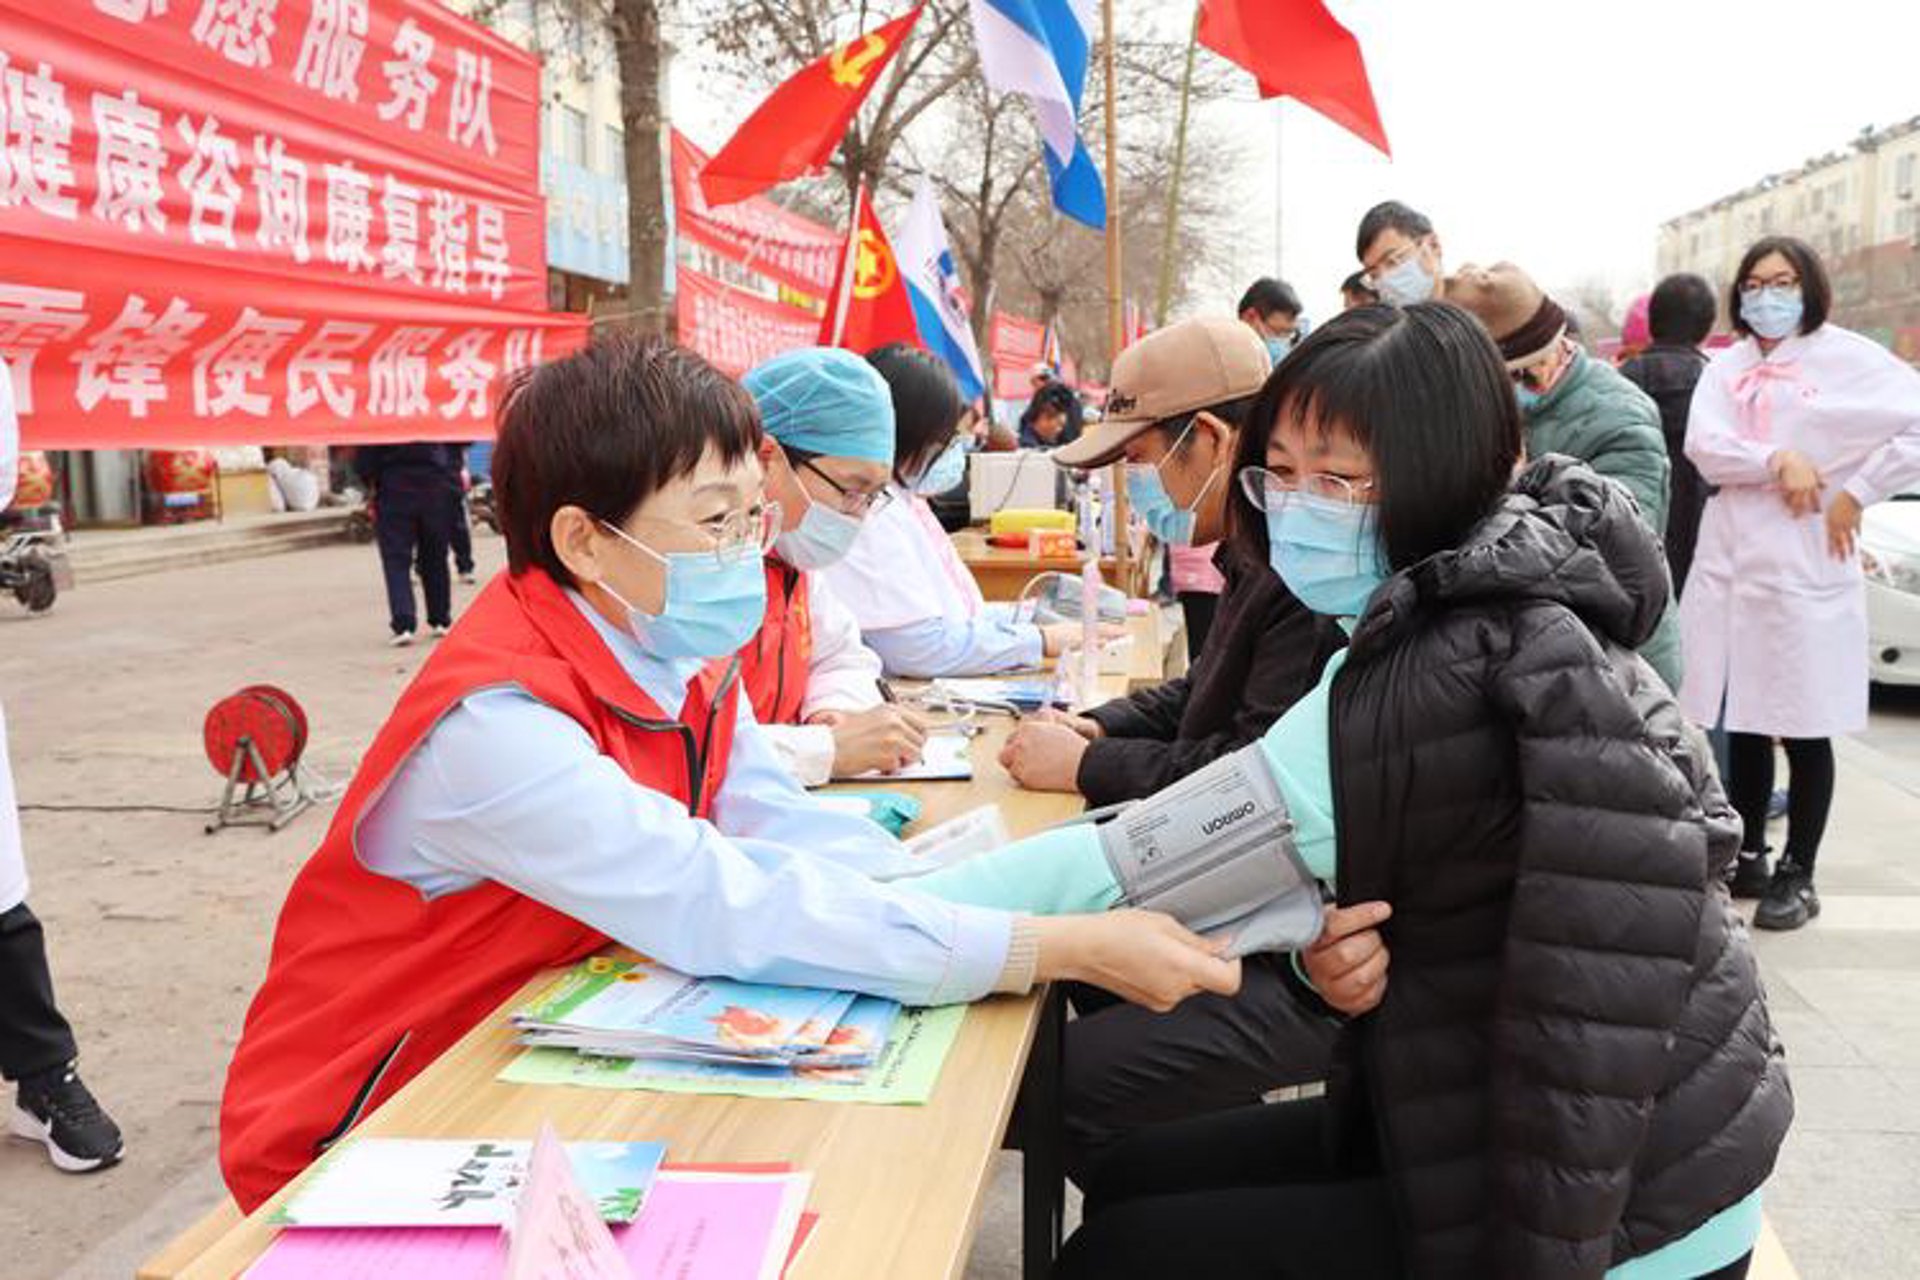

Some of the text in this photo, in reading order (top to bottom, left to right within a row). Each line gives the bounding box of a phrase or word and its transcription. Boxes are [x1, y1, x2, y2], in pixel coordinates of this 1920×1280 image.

[0, 51, 511, 300] 健康咨询康复指导
[92, 0, 498, 156] 愿服务队
